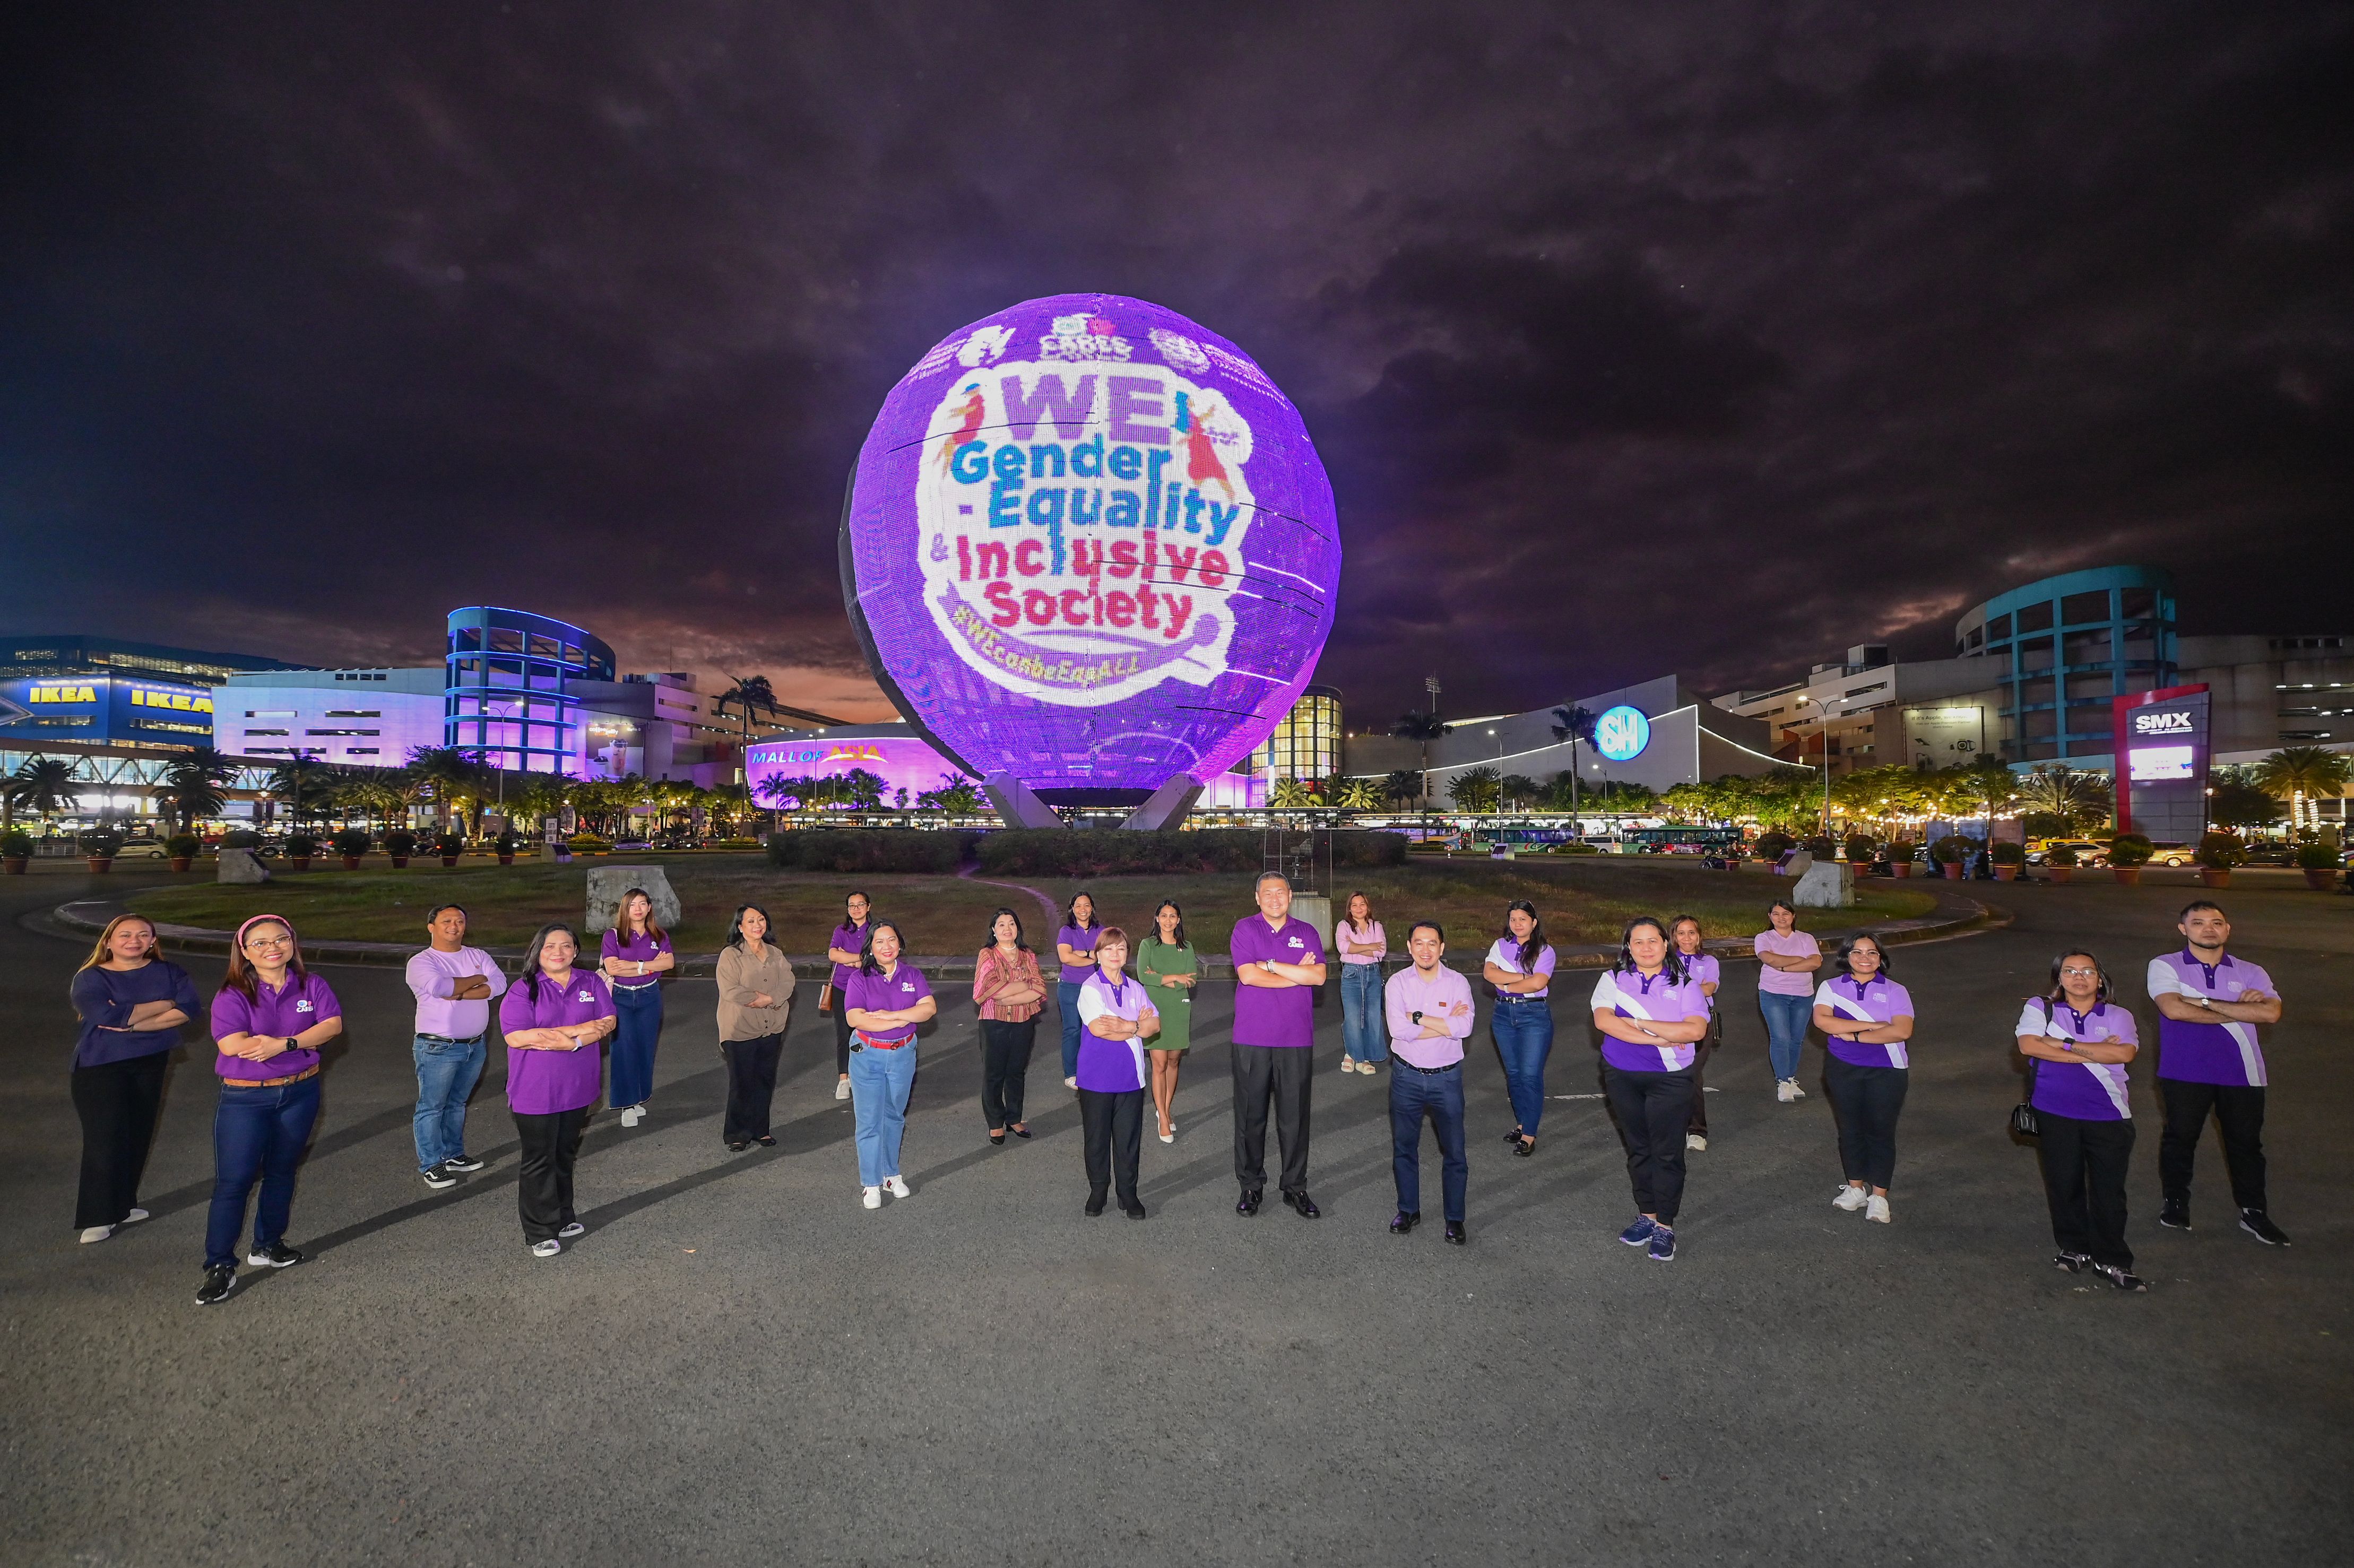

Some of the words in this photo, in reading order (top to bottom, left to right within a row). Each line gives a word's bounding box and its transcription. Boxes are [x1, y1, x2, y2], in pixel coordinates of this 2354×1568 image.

[1000, 374, 1171, 445] WE
[951, 432, 1173, 485] Gender
[988, 479, 1239, 546] Equality
[956, 531, 1229, 586] Inclusive
[984, 579, 1192, 639] Society
[30, 687, 97, 703] IKEA
[132, 689, 214, 714] IKEA
[1600, 713, 1638, 753] SM
[2136, 712, 2192, 730] SMX
[752, 751, 797, 764] MALL
[800, 751, 824, 763] OF
[829, 745, 881, 761] ASIA
